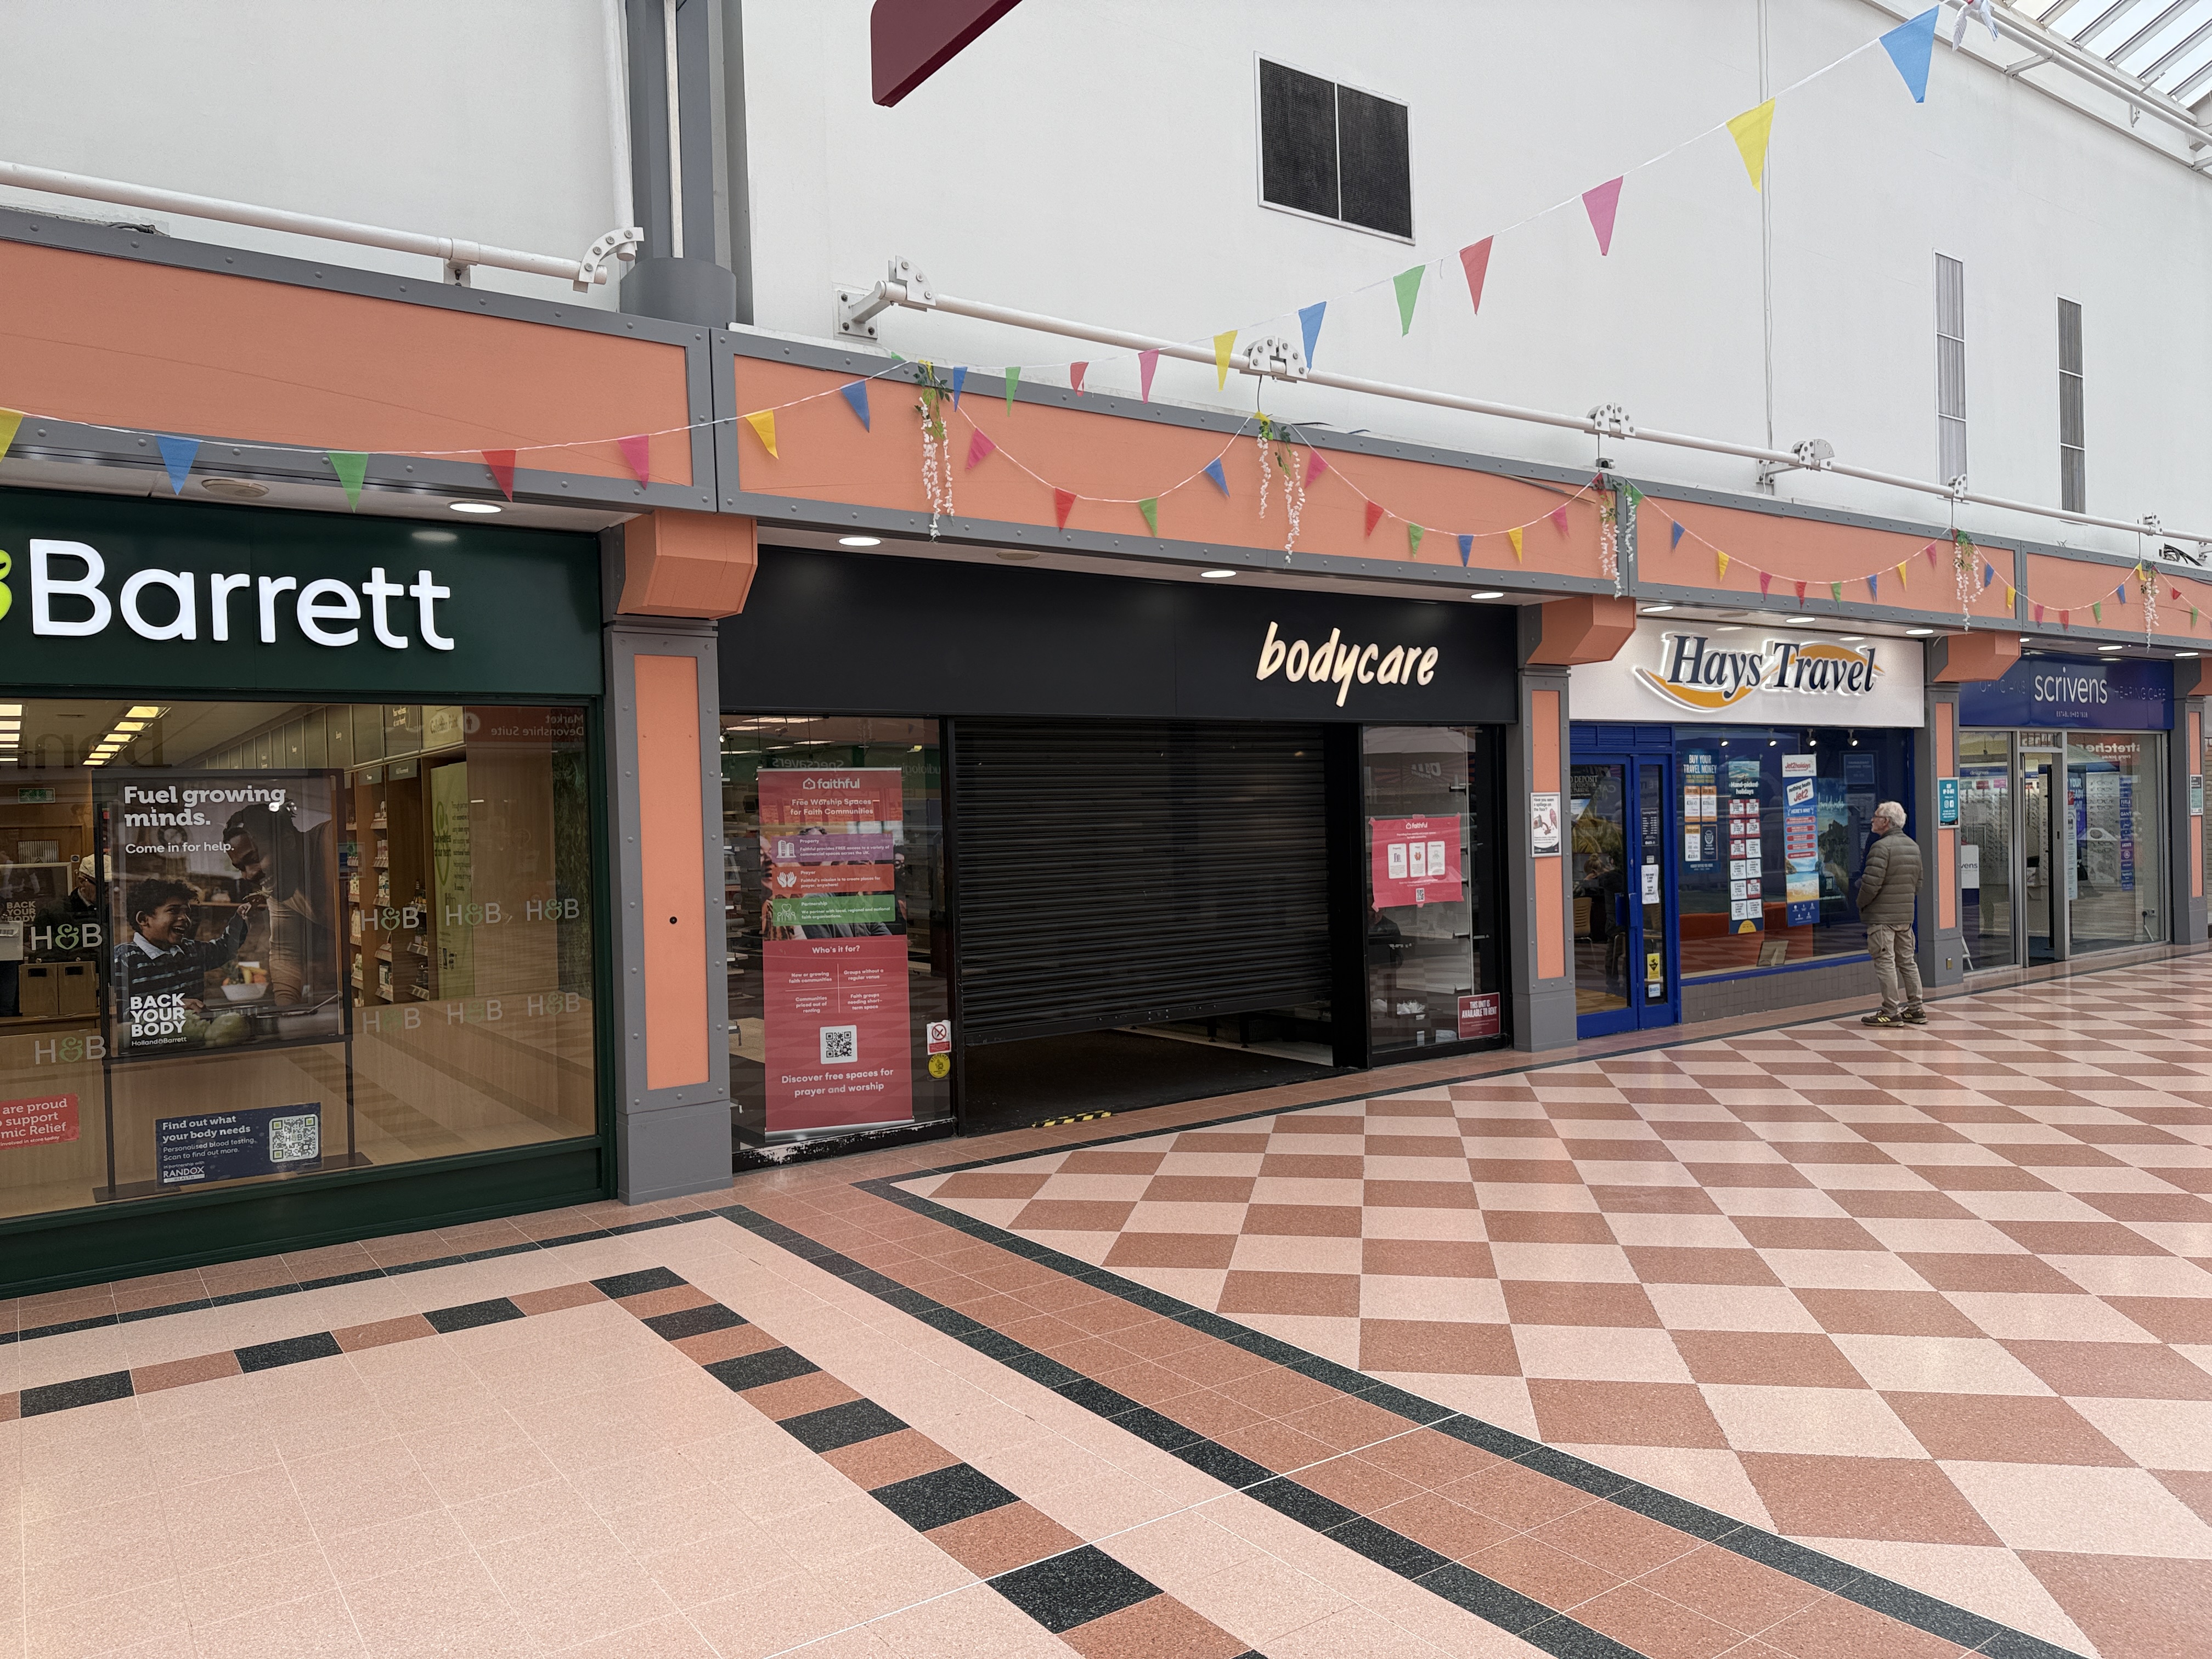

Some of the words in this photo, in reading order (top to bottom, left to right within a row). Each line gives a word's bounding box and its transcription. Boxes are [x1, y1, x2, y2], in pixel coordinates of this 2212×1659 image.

[30, 538, 455, 651] Barrett
[1256, 621, 1438, 707] bodycare
[1666, 634, 1764, 699] Hays
[1770, 641, 1876, 692] Travel
[1979, 679, 2026, 695] OPTICIANS
[2034, 666, 2108, 704] scrivens
[2114, 685, 2146, 700] HEARING
[2148, 687, 2166, 701] CARE
[1689, 755, 1699, 763] BUY
[1700, 755, 1711, 764] YOUR
[1683, 764, 1700, 774] TRAVEL
[1701, 765, 1717, 774] MONEY
[817, 778, 860, 789] faithful
[2069, 777, 2081, 788] YOUR
[125, 786, 178, 804] Fuel
[182, 785, 286, 807] growing
[1794, 789, 1808, 802] jet2
[125, 808, 211, 827] minds.
[125, 843, 165, 854] Come
[168, 843, 179, 853] in
[182, 842, 201, 851] for
[204, 842, 234, 853] help.
[7, 901, 36, 909] BACK
[525, 898, 580, 922] H&B
[360, 906, 420, 932] H&B
[445, 902, 502, 927] H&B
[31, 923, 103, 951] H&B
[131, 993, 185, 1009] BACK
[527, 991, 581, 1017] H&B
[130, 1007, 186, 1023] YOUR
[447, 999, 503, 1025] H&B
[1462, 1008, 1482, 1018] AVAILABLE
[1488, 1006, 1497, 1015] RENT
[132, 1020, 186, 1037] BODY
[362, 1007, 421, 1034] H&B
[35, 1035, 106, 1065] H&B
[781, 1074, 822, 1084] Discover
[825, 1071, 844, 1081] free
[846, 1069, 878, 1081] spaces
[881, 1068, 894, 1077] for
[794, 1086, 825, 1098] prayer
[828, 1084, 846, 1093] and
[848, 1082, 884, 1093] worship
[3, 1105, 23, 1114] are
[27, 1098, 67, 1114] proud
[5, 1112, 58, 1126] support
[162, 1121, 187, 1131] Find
[189, 1119, 207, 1128] out
[210, 1116, 236, 1125] what
[0, 1128, 26, 1138] mic
[30, 1122, 66, 1135] Relief
[162, 1133, 189, 1144] your
[190, 1129, 217, 1139] body
[219, 1126, 251, 1136] needs
[163, 1141, 207, 1153] Personalised
[163, 1166, 205, 1177] RANDOX
